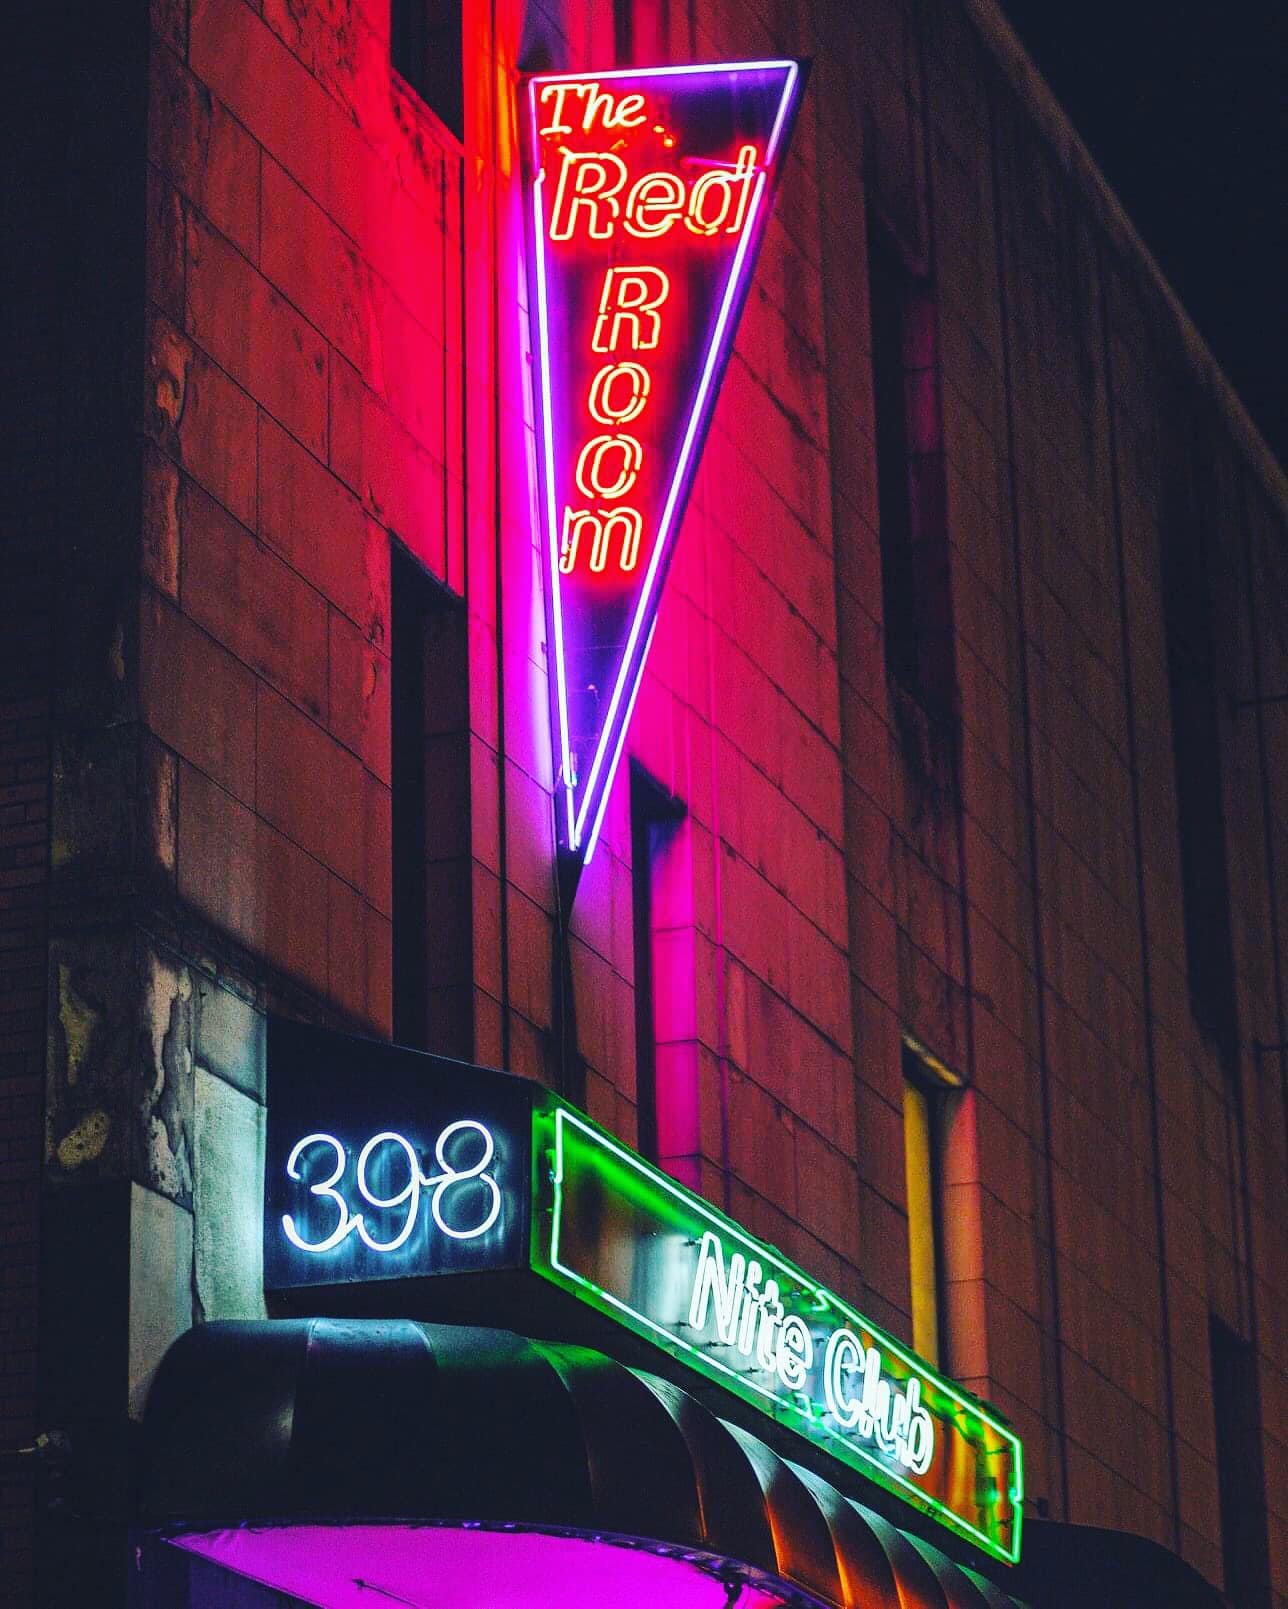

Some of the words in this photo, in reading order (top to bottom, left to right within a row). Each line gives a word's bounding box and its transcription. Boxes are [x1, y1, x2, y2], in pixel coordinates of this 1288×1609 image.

[539, 83, 647, 135] The
[549, 145, 757, 240] Red
[282, 1120, 500, 1252] 398
[689, 1231, 813, 1390] Nite
[824, 1328, 934, 1475] Club
